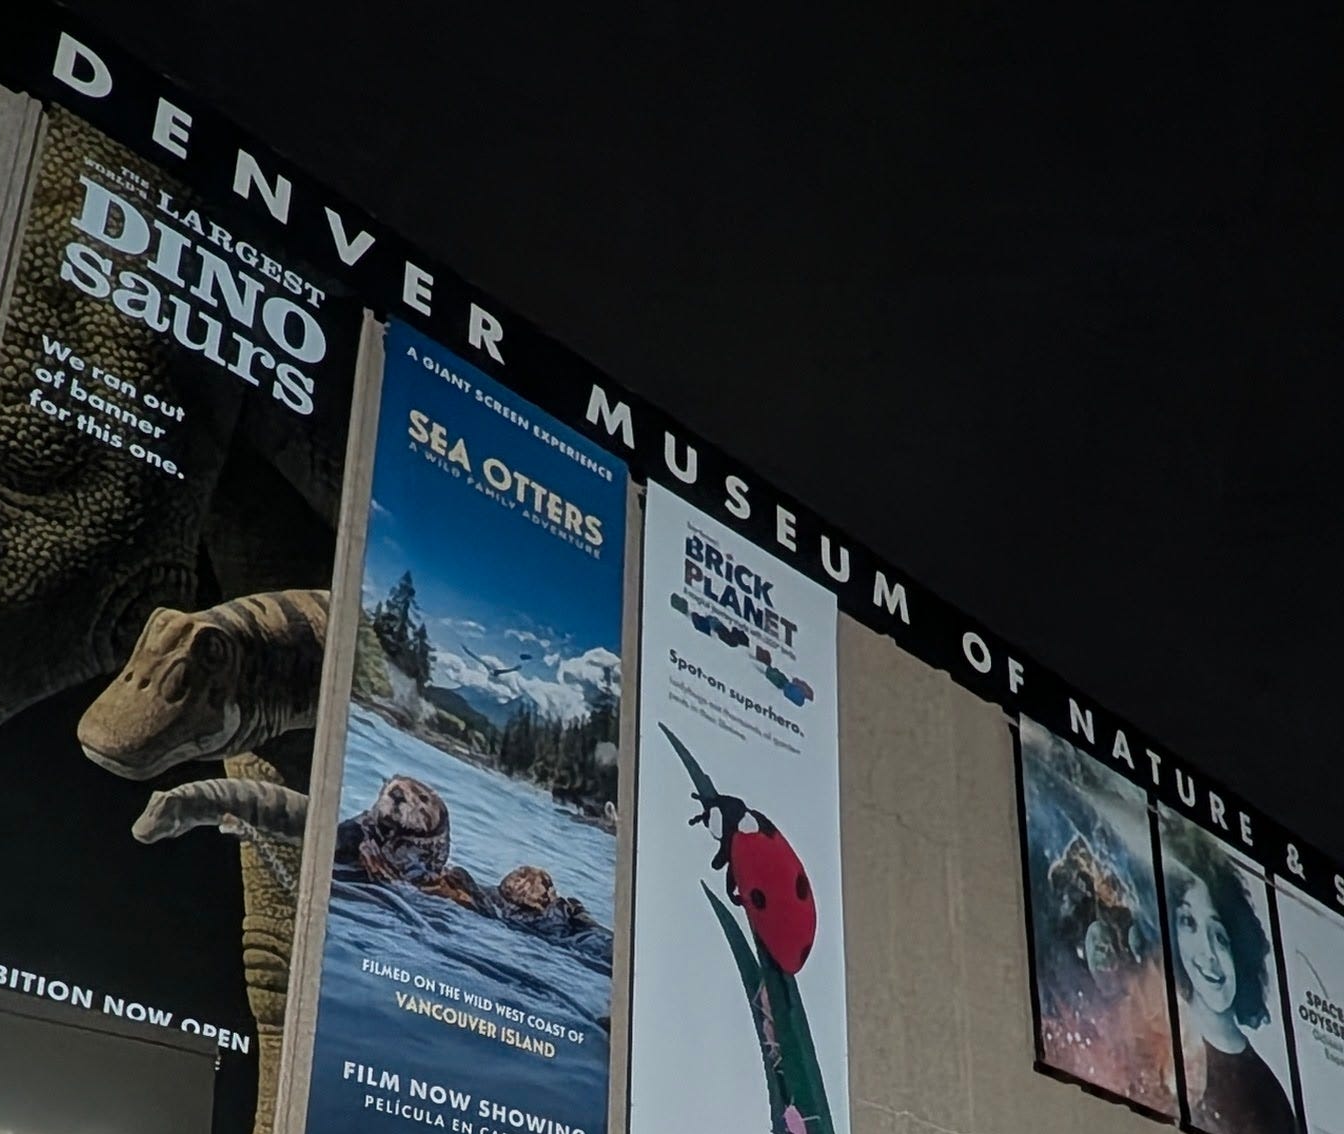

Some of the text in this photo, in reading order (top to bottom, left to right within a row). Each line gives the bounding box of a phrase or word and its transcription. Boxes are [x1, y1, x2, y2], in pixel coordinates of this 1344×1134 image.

[70, 174, 327, 364] DINO
[156, 189, 326, 309] LARGEST
[35, 368, 166, 439] of banner
[42, 334, 185, 422] We ran out
[406, 346, 614, 483] A GIANT SCREEN EXPERIENCE
[29, 388, 185, 480] for this one.
[53, 31, 505, 366] DENVER
[585, 384, 911, 626] MUSEUM
[963, 632, 1026, 695] OF
[1068, 697, 1253, 847] NATURE
[1286, 844, 1307, 881] &
[408, 409, 604, 546] SEA OTTERS
[424, 452, 461, 479] WILD
[466, 474, 517, 510] FAMILY
[522, 509, 601, 561] ADVENTURE
[684, 558, 798, 648] PLANET
[669, 648, 727, 694] Spot-on
[729, 687, 805, 738] superhero.
[102, 995, 173, 1027] NOW
[362, 959, 585, 1045] FILMED ON THE WILD WEST COAST OF
[395, 991, 556, 1058] VANCOUVER ISLAND
[1305, 990, 1344, 1024] SPACE
[343, 1060, 400, 1093] FILM
[410, 1078, 471, 1113] NOW
[364, 1094, 445, 1129] PELÍCULA
